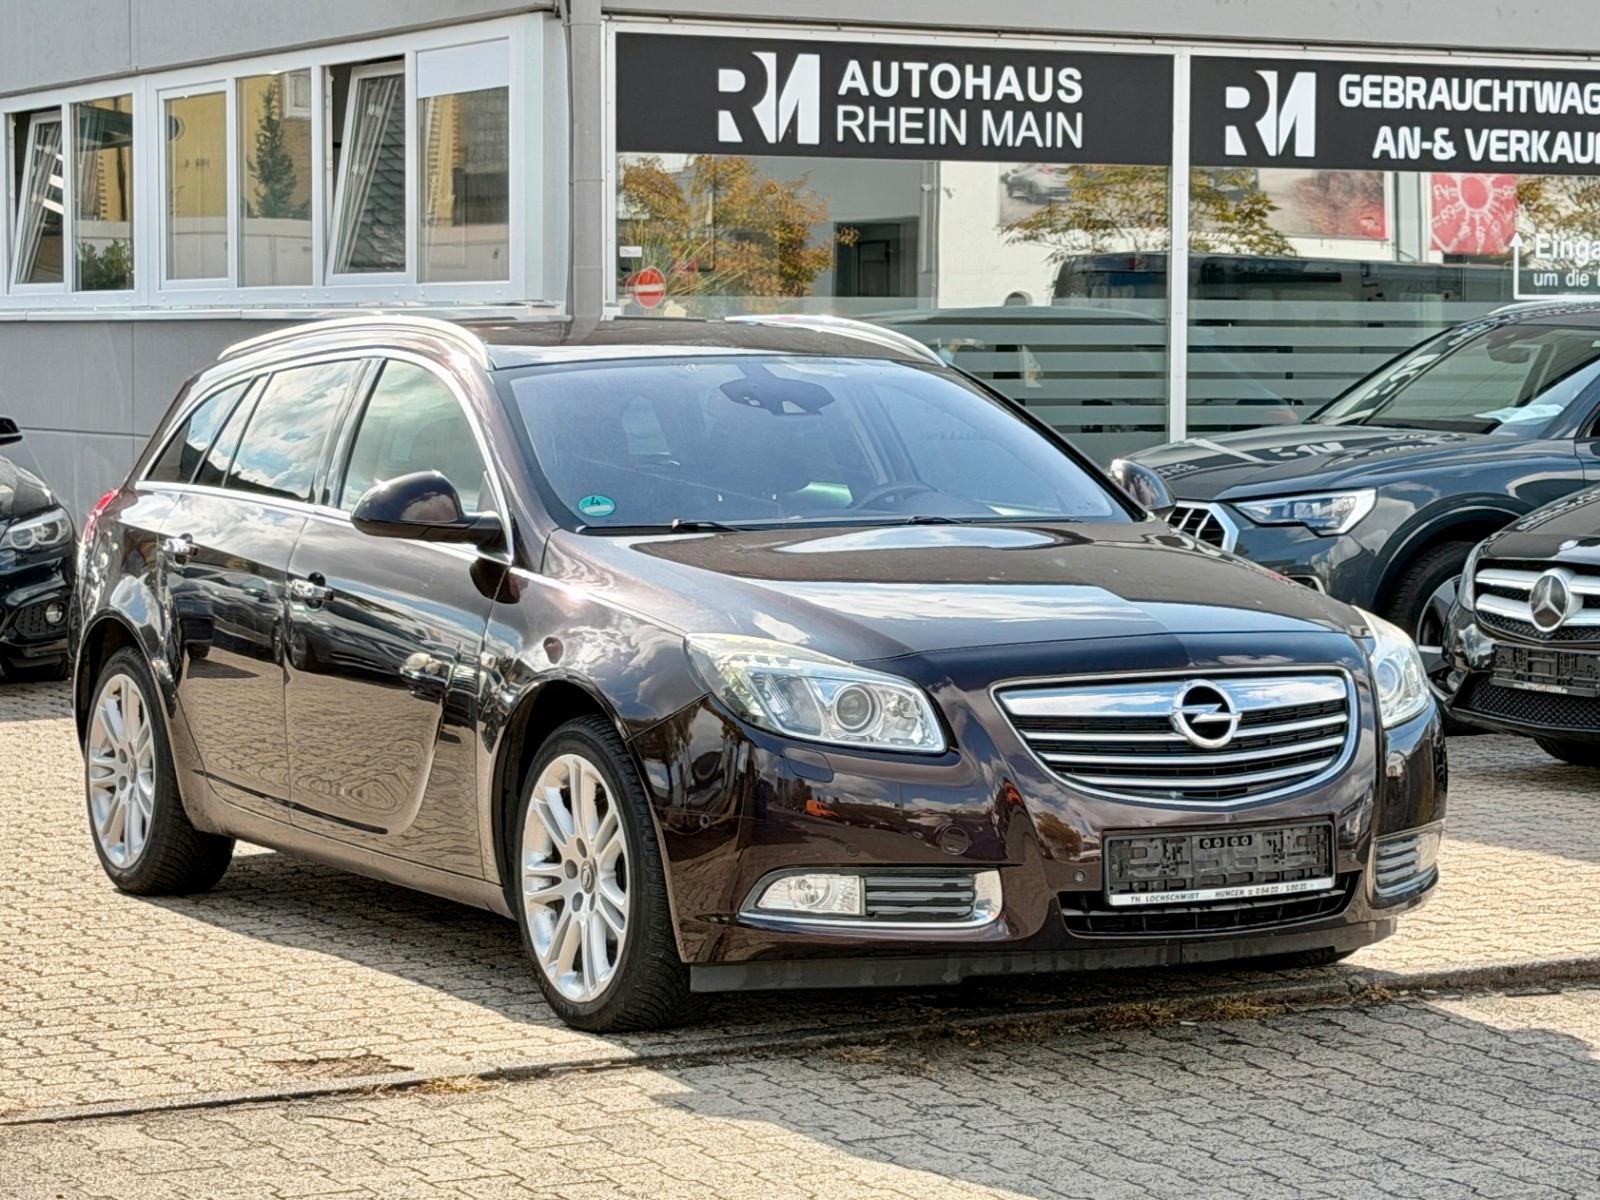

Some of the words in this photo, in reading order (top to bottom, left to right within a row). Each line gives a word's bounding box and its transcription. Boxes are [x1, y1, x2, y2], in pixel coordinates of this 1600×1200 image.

[719, 52, 821, 145] RM
[837, 59, 1084, 104] AUTOHAUS
[1339, 73, 1600, 115] GEBRAUCHTWAG
[837, 104, 967, 146] RHEIN
[982, 109, 1083, 149] MAIN
[1225, 70, 1317, 158] RM
[1464, 128, 1600, 165] VERKAU
[1533, 272, 1559, 288] um
[1565, 268, 1590, 288] die
